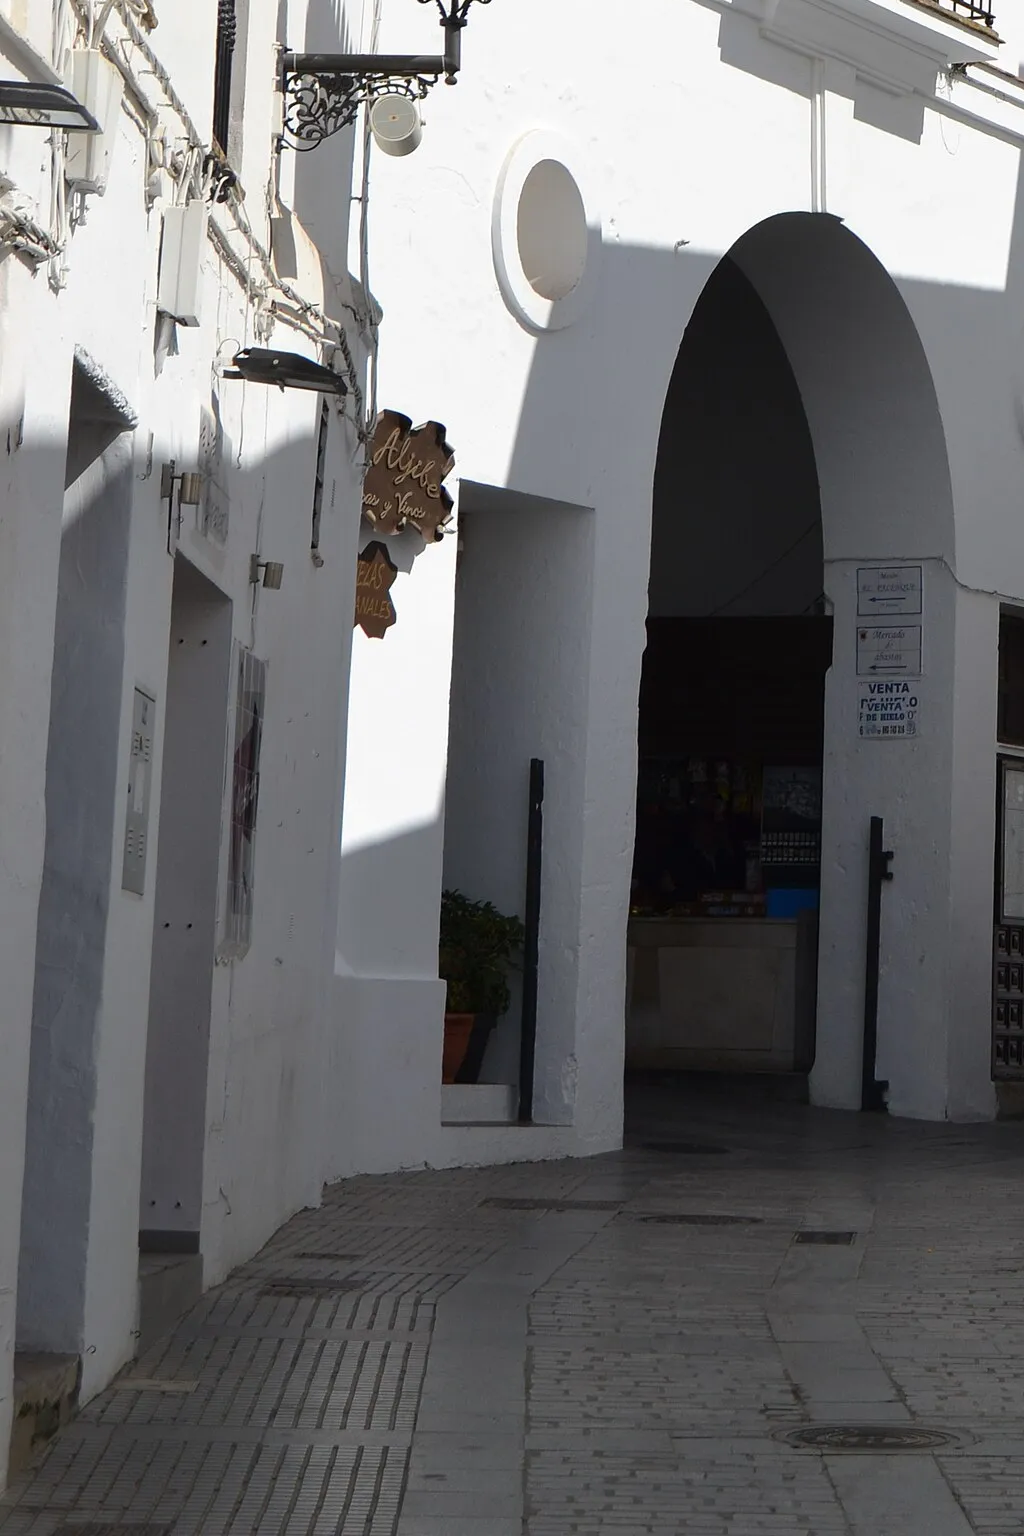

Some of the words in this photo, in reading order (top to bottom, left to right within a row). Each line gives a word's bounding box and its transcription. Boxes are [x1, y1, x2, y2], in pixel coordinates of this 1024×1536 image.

[373, 427, 440, 498] Aljibe
[380, 501, 392, 519] y
[395, 491, 426, 518] Vinos
[873, 629, 905, 639] Mercado
[868, 683, 909, 694] VENTA
[867, 703, 902, 711] VENTA
[866, 713, 876, 721] DE
[880, 713, 904, 721] HIELO
